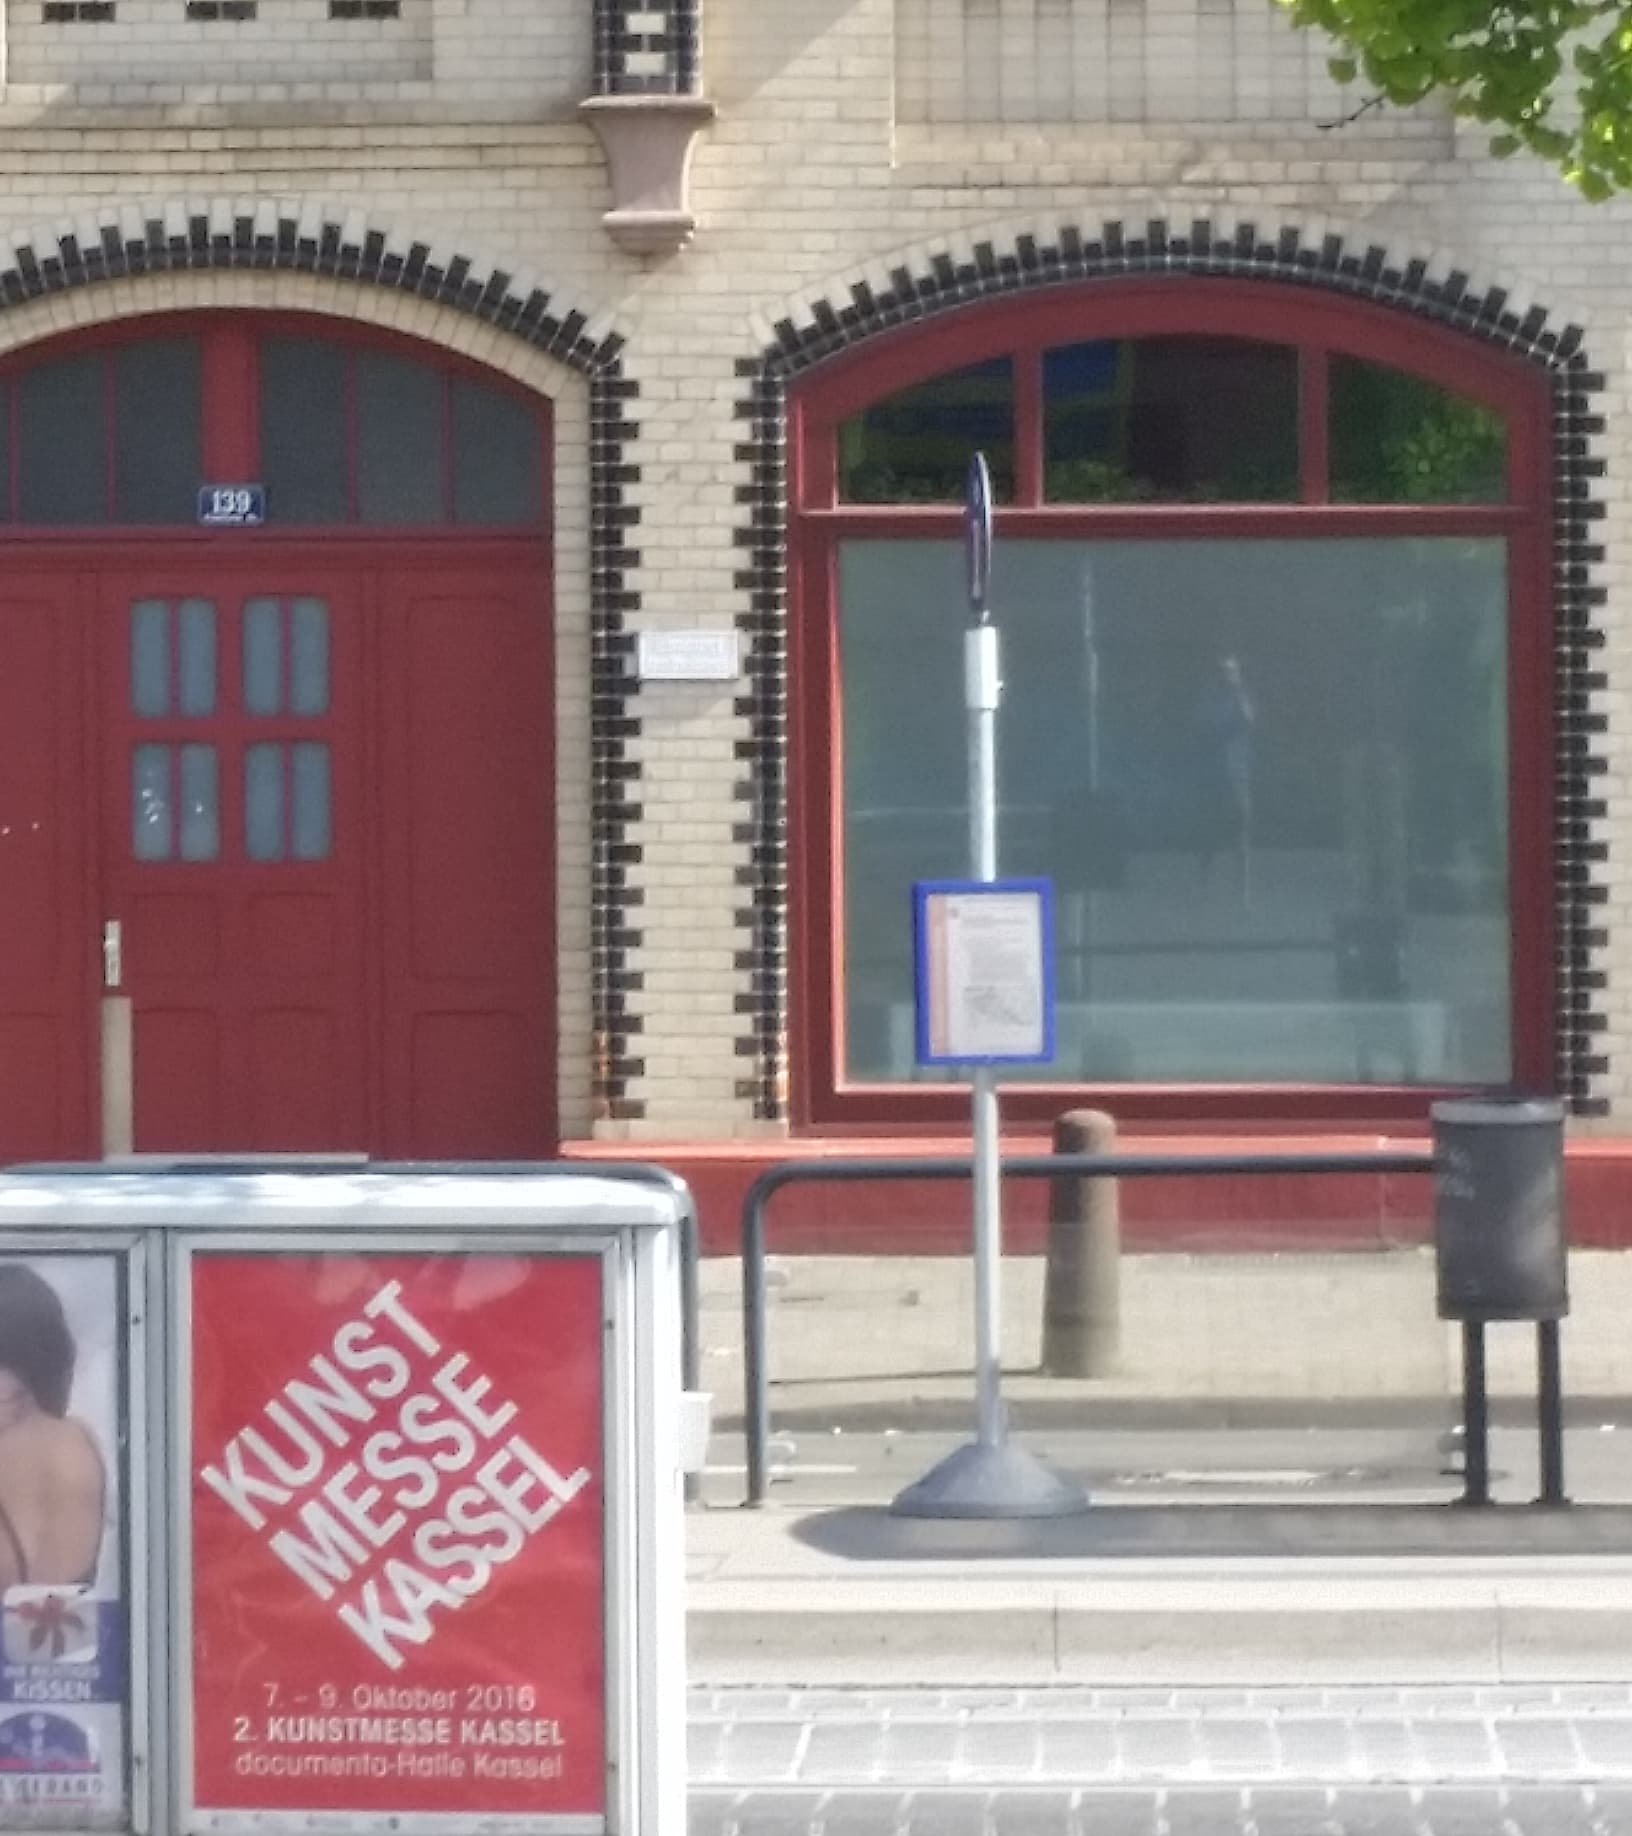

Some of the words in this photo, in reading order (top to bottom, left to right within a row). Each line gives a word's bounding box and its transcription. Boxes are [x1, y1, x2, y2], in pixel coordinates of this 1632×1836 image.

[213, 490, 250, 514] 139
[201, 1279, 441, 1531] KUNST
[268, 1353, 518, 1600] MESSE
[337, 1434, 591, 1670] KASSEL
[353, 1685, 458, 1710] Oktober
[268, 1718, 451, 1743] KUNSTMESSE
[461, 1720, 566, 1745] KASSEL
[235, 1752, 465, 1778] documenta-Halle
[474, 1754, 563, 1779] Kassel
